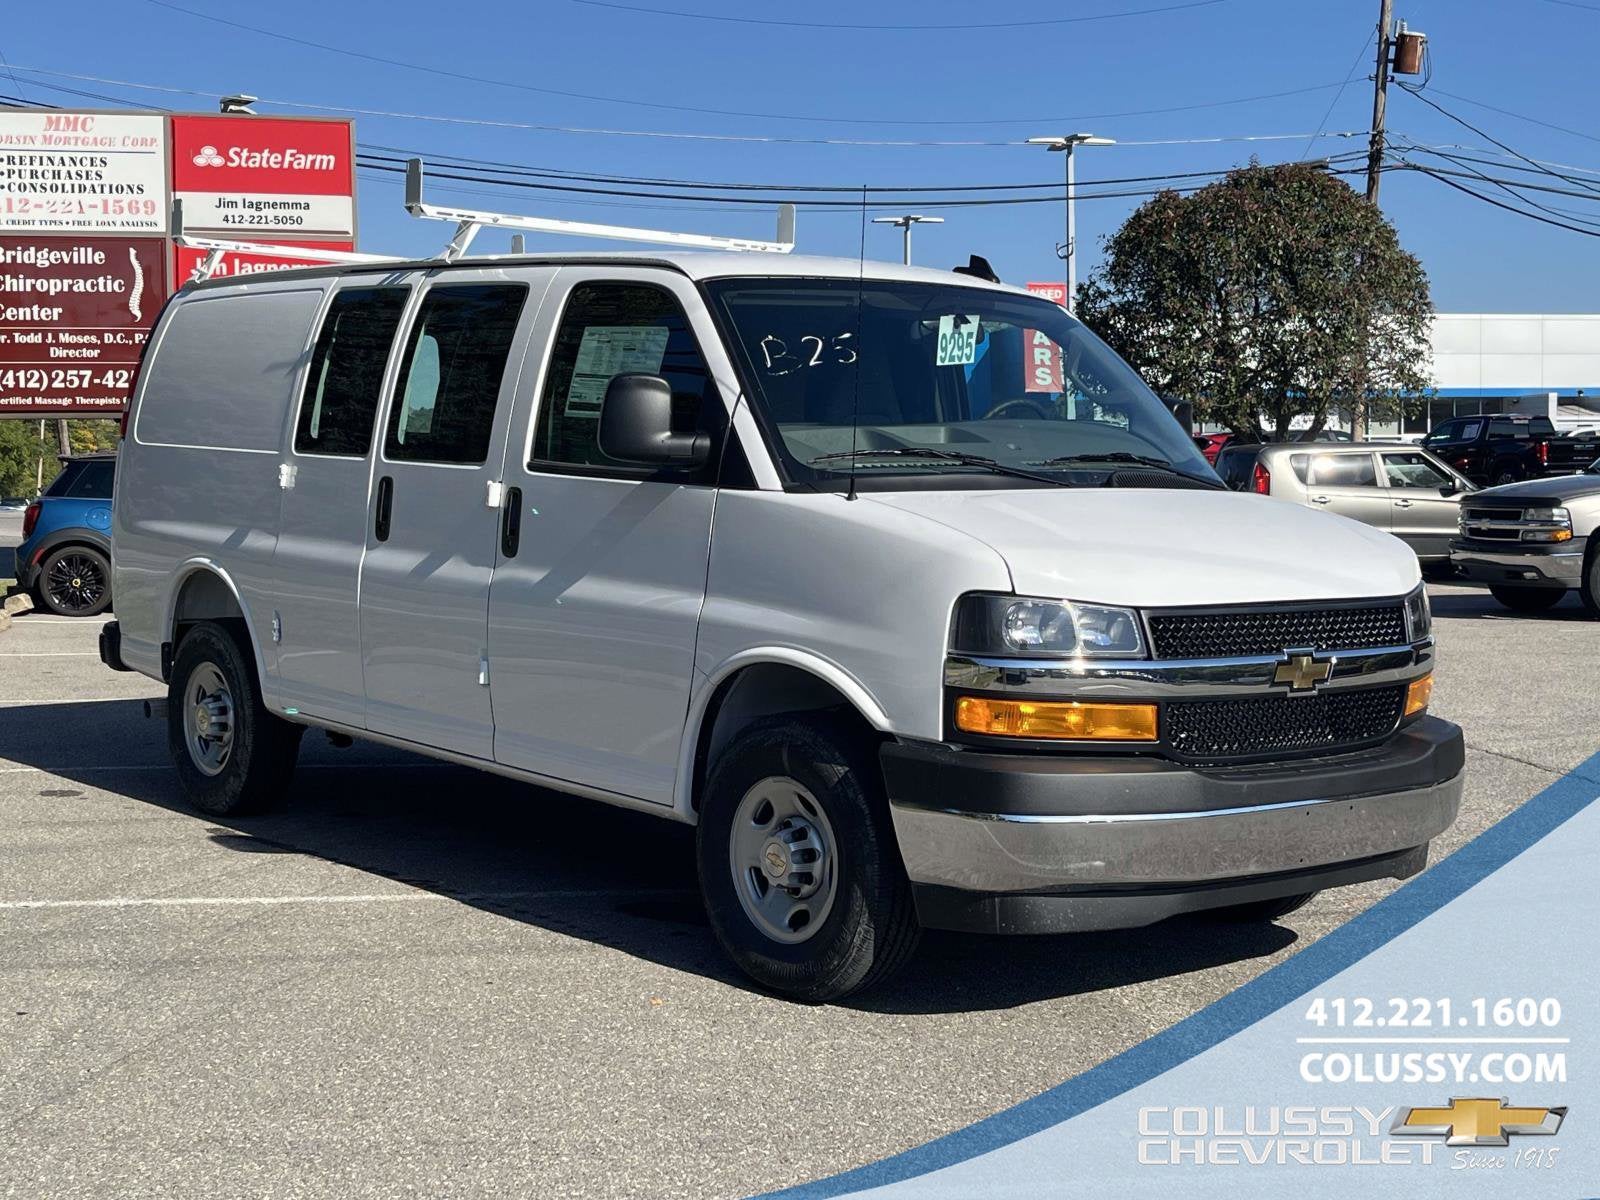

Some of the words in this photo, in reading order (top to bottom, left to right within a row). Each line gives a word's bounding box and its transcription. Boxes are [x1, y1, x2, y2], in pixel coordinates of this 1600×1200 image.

[43, 115, 95, 132] MMC
[7, 155, 108, 168] REFINANCES
[7, 169, 103, 181] PURCHASES
[7, 182, 145, 195] CONSOLIDATIONS
[0, 197, 156, 215] 12-221-1569
[215, 198, 238, 209] Jim
[119, 220, 158, 228] ANALYSIS
[222, 214, 303, 225] 412-221-5050
[13, 332, 43, 344] Todd
[45, 333, 56, 344] J.
[59, 333, 101, 345] Moses,
[50, 347, 101, 358] Director
[940, 331, 974, 364] 9295
[51, 369, 135, 389] 257-42
[0, 396, 32, 405] ertified
[34, 396, 73, 406] Massage
[75, 396, 120, 406] Therapists
